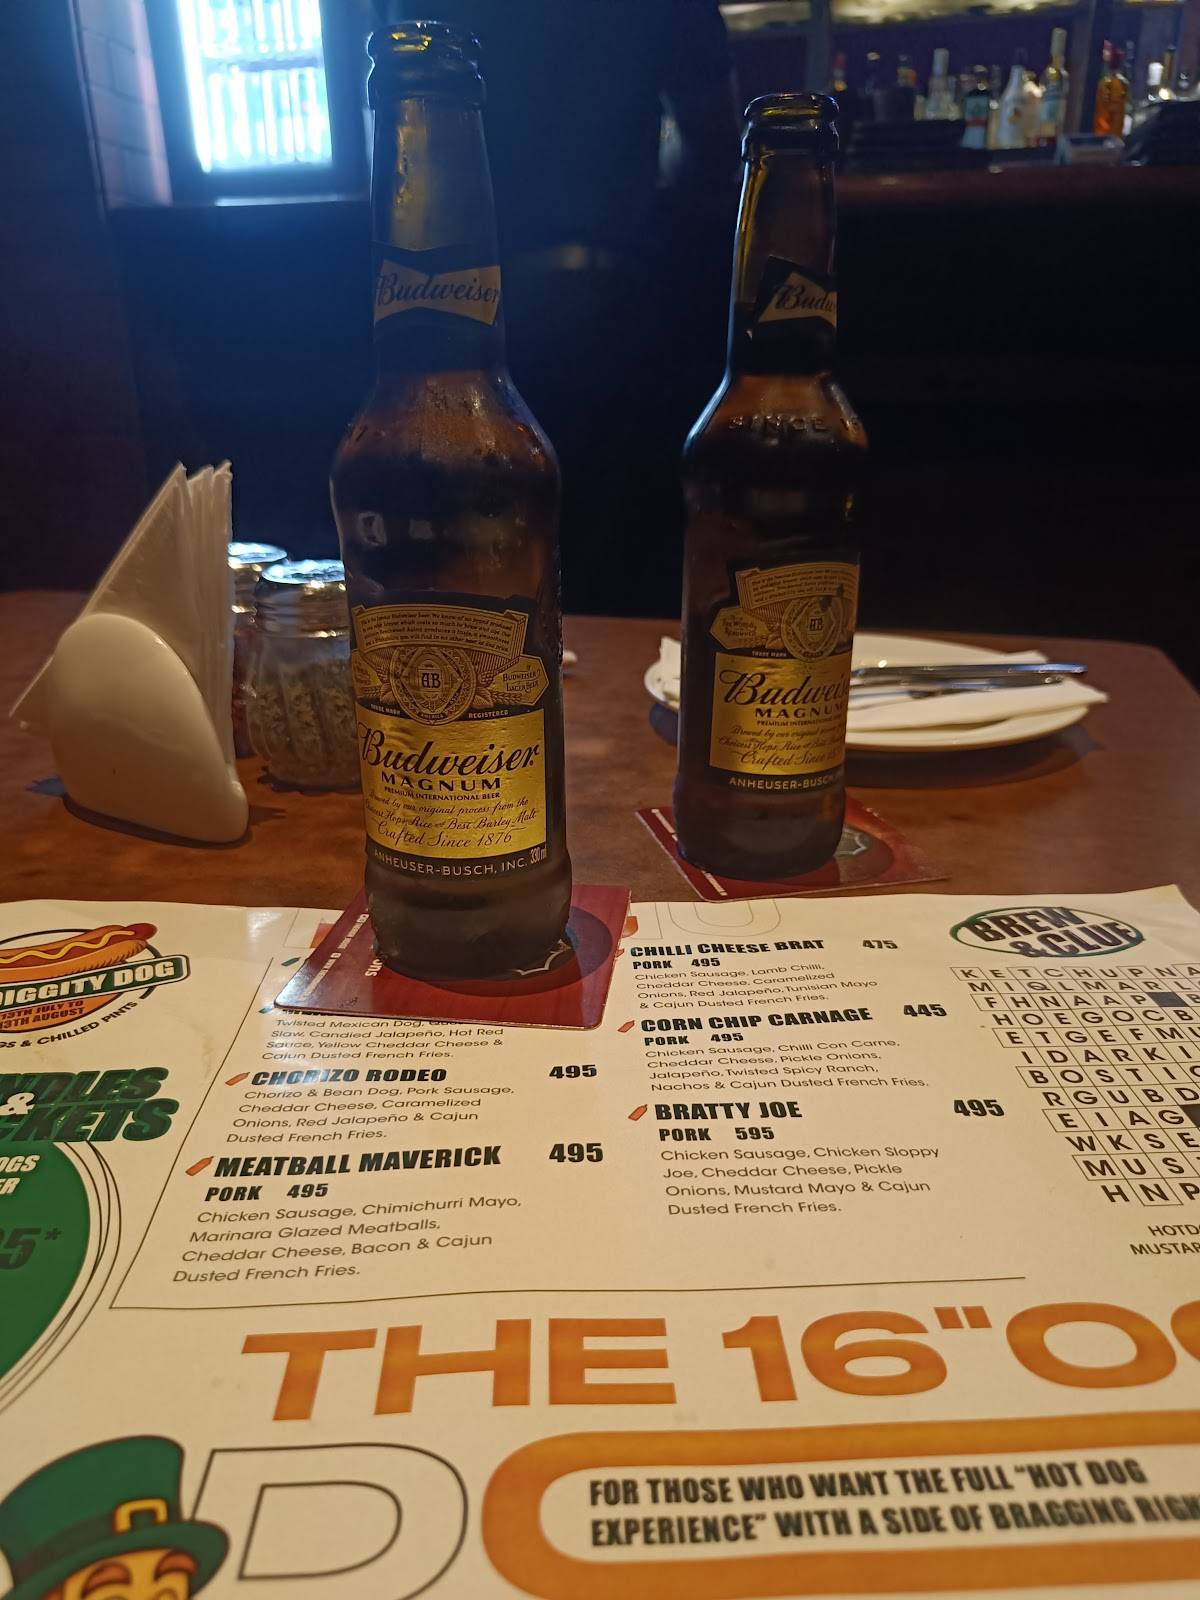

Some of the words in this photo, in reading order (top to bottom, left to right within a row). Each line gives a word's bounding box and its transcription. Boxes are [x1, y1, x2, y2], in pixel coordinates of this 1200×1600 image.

[469, 710, 509, 719] REGISTERED
[359, 722, 539, 775] Budweiser
[381, 771, 500, 791] MAGNUM
[415, 792, 480, 800] INTERNATIONAL
[482, 792, 500, 800] BEER
[419, 803, 455, 816] original
[457, 805, 490, 815] process
[492, 801, 514, 815] from
[377, 821, 425, 846] Crafted
[427, 831, 471, 848] Since
[476, 828, 512, 848] 1876
[964, 907, 1086, 942] BREW
[630, 944, 693, 957] CHILLI
[697, 943, 769, 954] CHEESE
[774, 940, 825, 951] BRAT
[862, 939, 899, 950] 475
[632, 960, 673, 969] PORK
[691, 958, 721, 967] 495
[114, 961, 175, 987] DOG
[634, 970, 687, 981] Chicken
[690, 970, 749, 979] Sausage,
[752, 972, 835, 985] Caramelized
[840, 980, 878, 990] Mayo
[32, 1007, 86, 1023] AUGUST
[34, 1003, 63, 1014] JULY
[68, 1000, 84, 1008] TO
[37, 1021, 100, 1045] CHILLED
[101, 1001, 138, 1023] PINTS
[330, 1020, 389, 1028] Mexican
[641, 1016, 703, 1032] CORN
[708, 1015, 762, 1030] CHIP
[767, 1007, 873, 1026] CARNAGE
[903, 1003, 948, 1018] 445
[309, 1029, 371, 1038] Candied
[449, 1028, 472, 1036] Hot
[477, 1028, 504, 1036] Red
[644, 1035, 690, 1046] PORK
[710, 1032, 744, 1042] 495
[317, 1040, 361, 1048] Yellow
[366, 1040, 431, 1048] Cheddar
[434, 1039, 489, 1047] Cheese
[261, 1051, 306, 1061] Cajun
[311, 1051, 361, 1059] Dusted
[365, 1050, 414, 1058] French
[646, 1047, 705, 1058] Chicken
[647, 1058, 714, 1068] Cheddar
[780, 1053, 822, 1063] Pickle
[251, 1068, 360, 1086] CHORIZO
[365, 1068, 448, 1082] RODEO
[548, 1064, 598, 1080] 495
[726, 1067, 779, 1076] Twisted
[783, 1065, 822, 1076] Spicy
[244, 1090, 302, 1099] Chorizo
[323, 1088, 363, 1097] Bean
[368, 1087, 403, 1097] Dog,
[407, 1086, 439, 1095] Pork
[444, 1085, 515, 1096] Sausage,
[650, 1081, 710, 1092] Nachos
[730, 1078, 775, 1090] Cajun
[780, 1078, 833, 1088] Dusted
[837, 1077, 888, 1087] French
[239, 1103, 310, 1113] Cheddar
[315, 1101, 377, 1112] Cheese,
[382, 1098, 481, 1109] Caramelized
[654, 1102, 750, 1120] BRATTY
[758, 1101, 803, 1118] JOE
[953, 1098, 1005, 1117] 495
[233, 1118, 292, 1129] Onions,
[297, 1116, 326, 1127] Red
[331, 1112, 408, 1126] Jalapeño
[430, 1111, 479, 1123] Cajun
[226, 1133, 283, 1144] Dusted
[288, 1131, 342, 1142] French
[347, 1129, 387, 1140] Fries.
[659, 1128, 712, 1142] PORK
[735, 1126, 775, 1140] 595
[214, 1154, 351, 1177] MEATBALL
[358, 1145, 502, 1172] MAVERICK
[548, 1142, 604, 1163] 495
[660, 1149, 729, 1162] Chicken
[734, 1148, 810, 1161] Sausage,
[813, 1147, 881, 1158] Chicken
[884, 1146, 939, 1159] Sloppy
[663, 1168, 698, 1178] Joe,
[701, 1166, 778, 1178] Cheddar
[782, 1165, 851, 1176] Cheese,
[854, 1164, 902, 1174] Pickle
[204, 1185, 263, 1201] PORK
[287, 1183, 329, 1198] 495
[665, 1184, 730, 1197] Onions,
[734, 1183, 804, 1195] Mustard
[808, 1182, 856, 1195] Mayo
[861, 1182, 874, 1192] &
[878, 1180, 930, 1194] Cajun
[197, 1207, 270, 1223] Chicken
[275, 1206, 356, 1222] Sausage,
[362, 1198, 463, 1216] Chimichurri
[468, 1196, 522, 1209] Mayo,
[668, 1204, 729, 1215] Dusted
[734, 1202, 794, 1214] French
[798, 1201, 842, 1212] Fries.
[189, 1230, 272, 1243] Marinara
[278, 1225, 342, 1239] Glazed
[348, 1219, 441, 1234] Meatballs,
[182, 1249, 267, 1262] Cheddar
[271, 1245, 346, 1259] Cheese,
[351, 1240, 410, 1255] Bacon
[417, 1238, 430, 1250] &
[436, 1235, 492, 1249] Cajun
[173, 1269, 240, 1282] Dusted
[245, 1265, 309, 1280] French
[314, 1264, 360, 1277] Fries.
[240, 1315, 679, 1423] THE
[1005, 1300, 1200, 1391] O
[590, 1479, 640, 1506] FOR
[646, 1477, 734, 1504] THOSE
[738, 1474, 804, 1500] WHO
[808, 1470, 890, 1498] WANT
[894, 1468, 948, 1494] THE
[950, 1465, 1014, 1492] FULL
[1085, 1458, 1148, 1485] DOG
[774, 1508, 851, 1538] WITH
[858, 1508, 879, 1535] A
[881, 1504, 948, 1535] SIDE
[950, 1503, 982, 1532] OF
[988, 1496, 1136, 1530] BRAGGING
